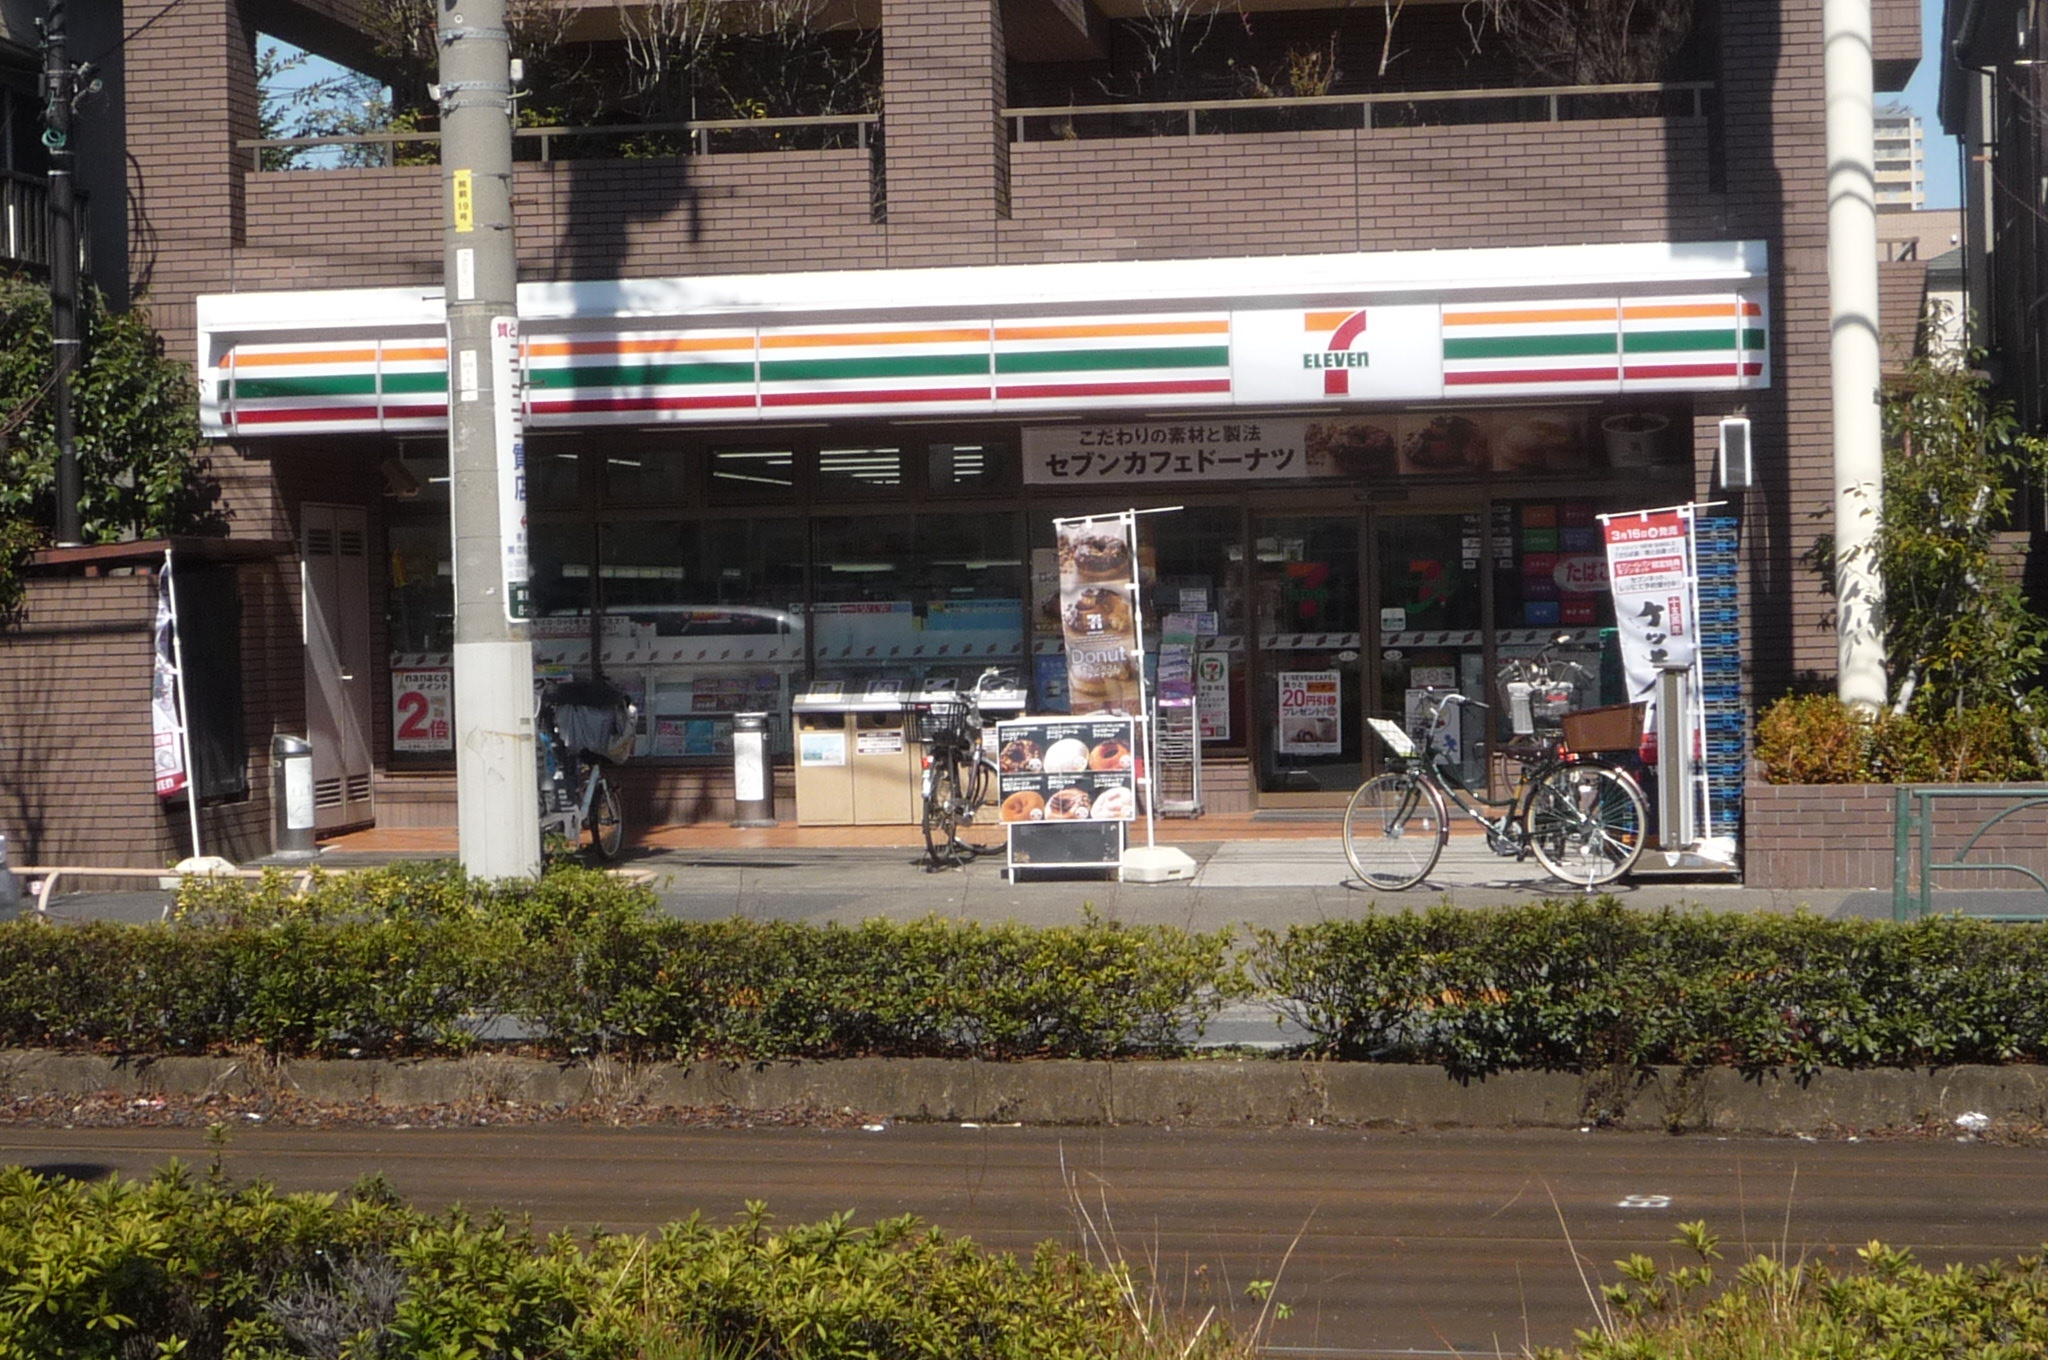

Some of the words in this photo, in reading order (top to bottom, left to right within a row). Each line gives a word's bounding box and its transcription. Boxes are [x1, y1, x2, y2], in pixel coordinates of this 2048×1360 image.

[1080, 424, 1262, 447] こだわりの素材と製法
[1046, 447, 1295, 477] セブンカフェドーナツ
[1071, 646, 1127, 664] Donut
[405, 673, 448, 682] nanaco
[417, 682, 448, 690] ポイント
